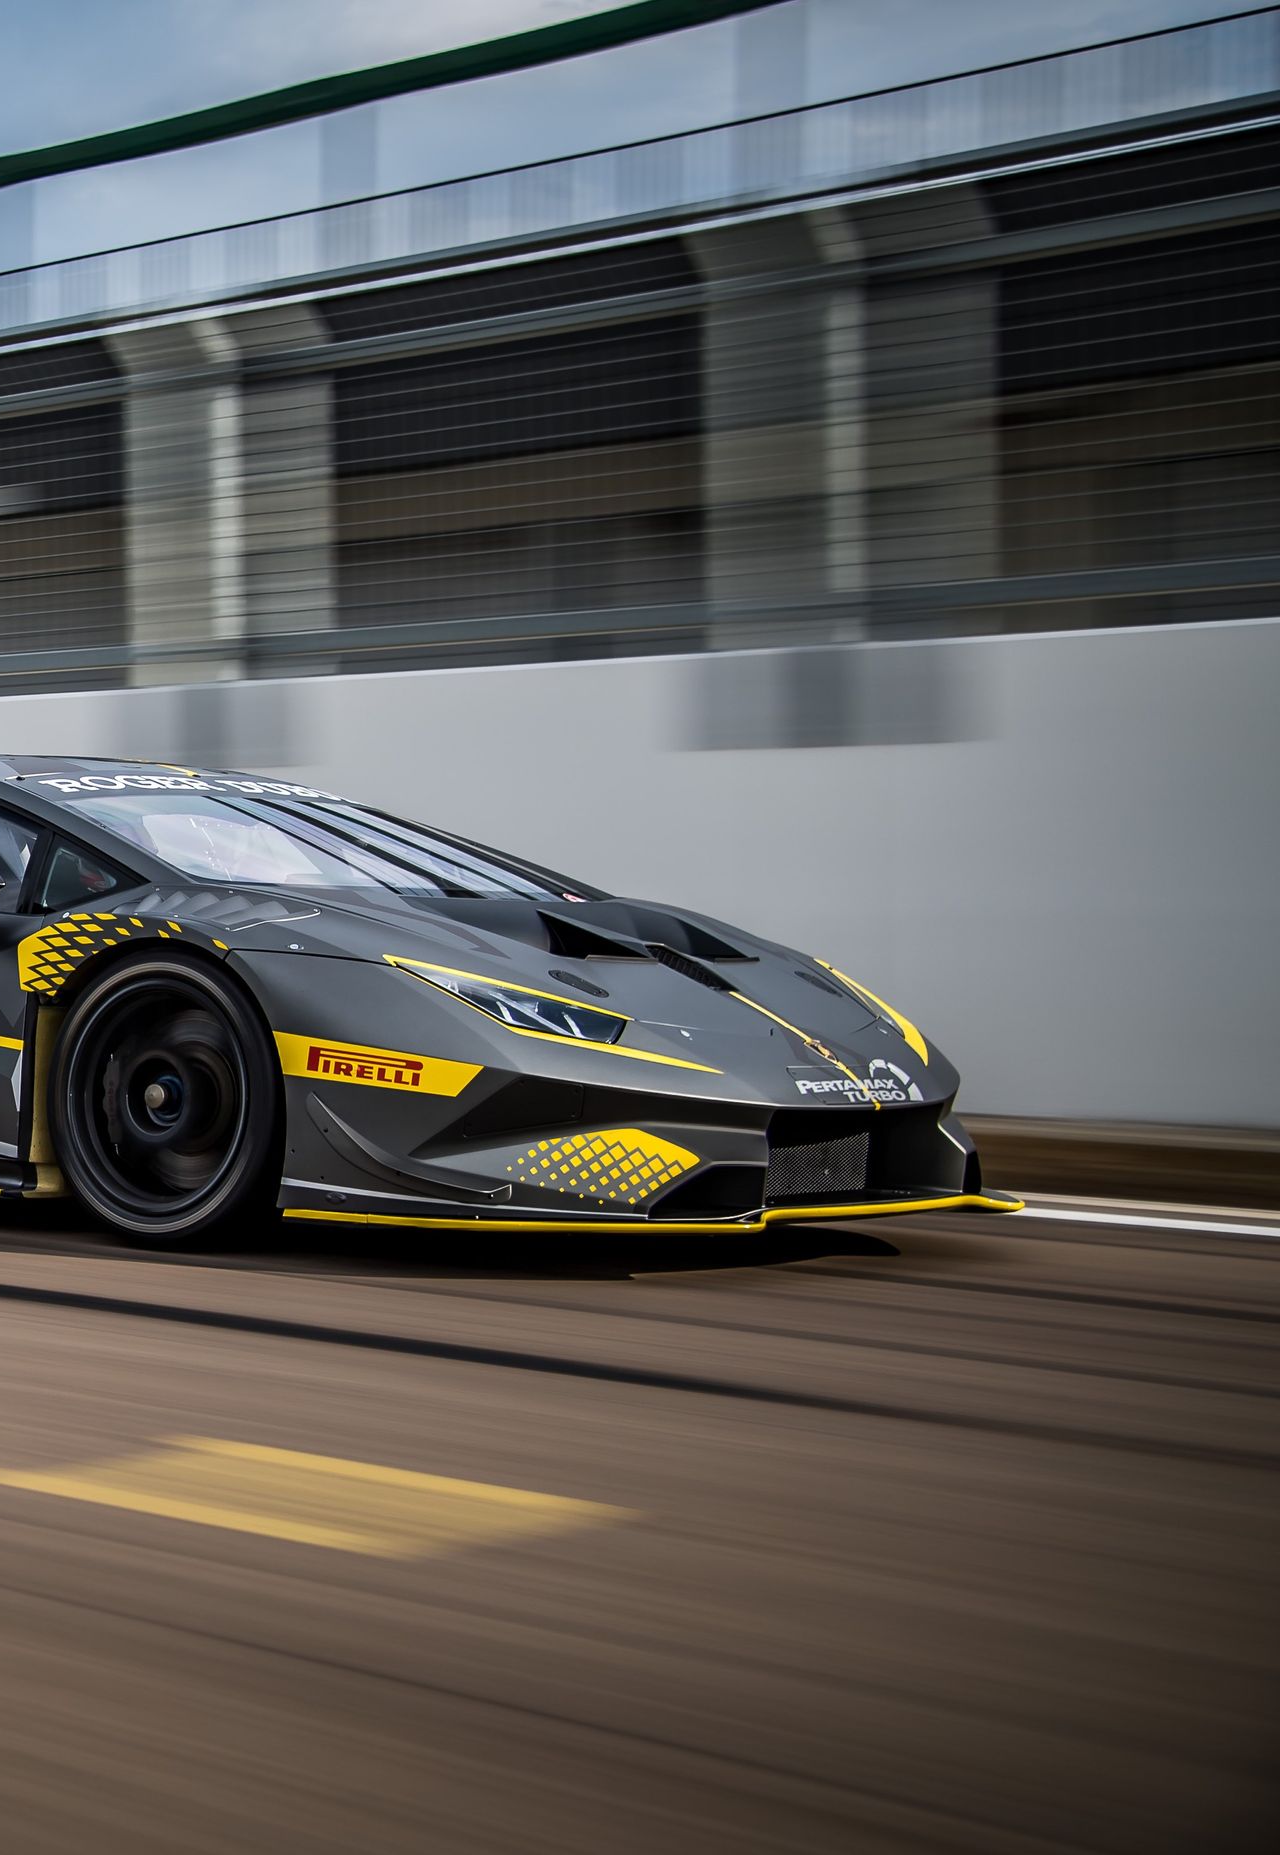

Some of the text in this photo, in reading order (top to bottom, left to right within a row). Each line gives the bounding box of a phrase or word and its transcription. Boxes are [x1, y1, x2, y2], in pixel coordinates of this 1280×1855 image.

[38, 775, 227, 793] ROGER
[306, 1045, 424, 1087] PIRELLI
[795, 1079, 899, 1095] PERTAMAX
[843, 1090, 906, 1103] TURBO
